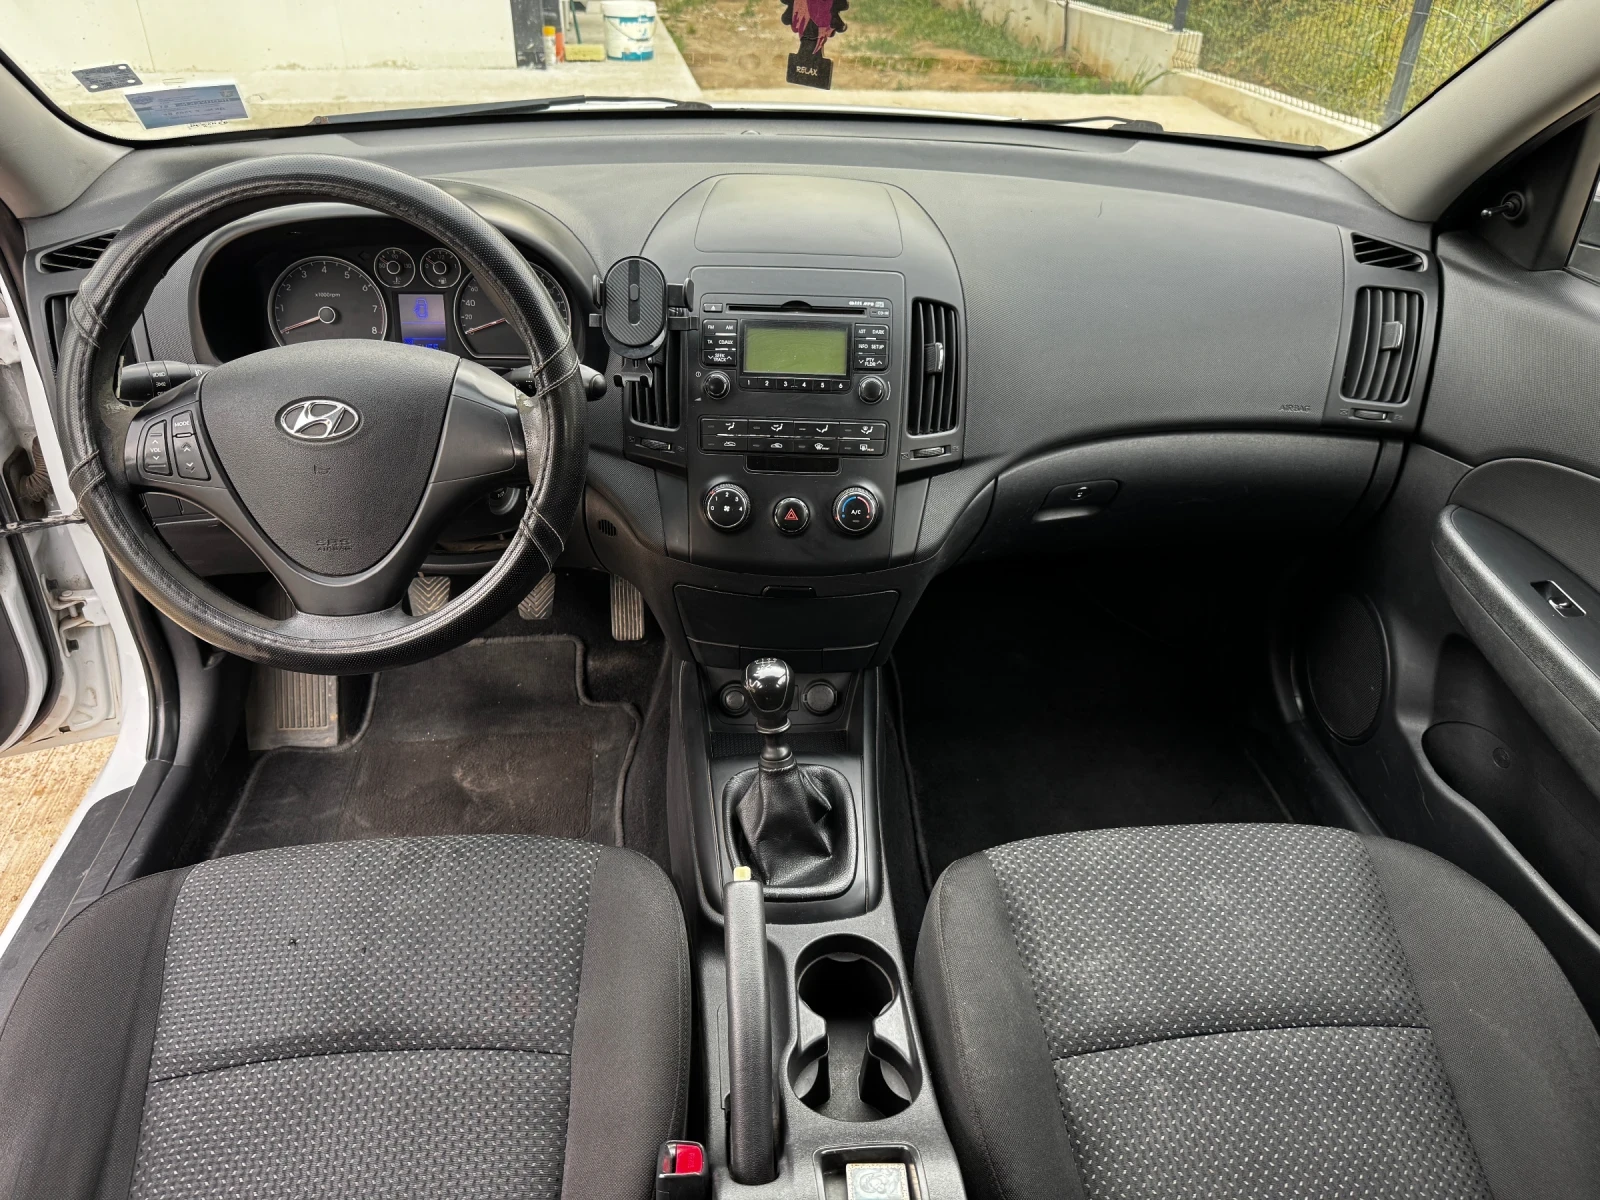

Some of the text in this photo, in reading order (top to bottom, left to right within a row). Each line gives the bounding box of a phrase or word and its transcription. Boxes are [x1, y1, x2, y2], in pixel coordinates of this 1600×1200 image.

[796, 65, 818, 76] RELAX
[321, 266, 328, 274] 4
[301, 270, 307, 279] 3
[344, 270, 350, 279] 5
[465, 299, 476, 307] 40
[372, 305, 378, 313] 7
[371, 326, 377, 335] 8
[174, 420, 191, 428] MODE
